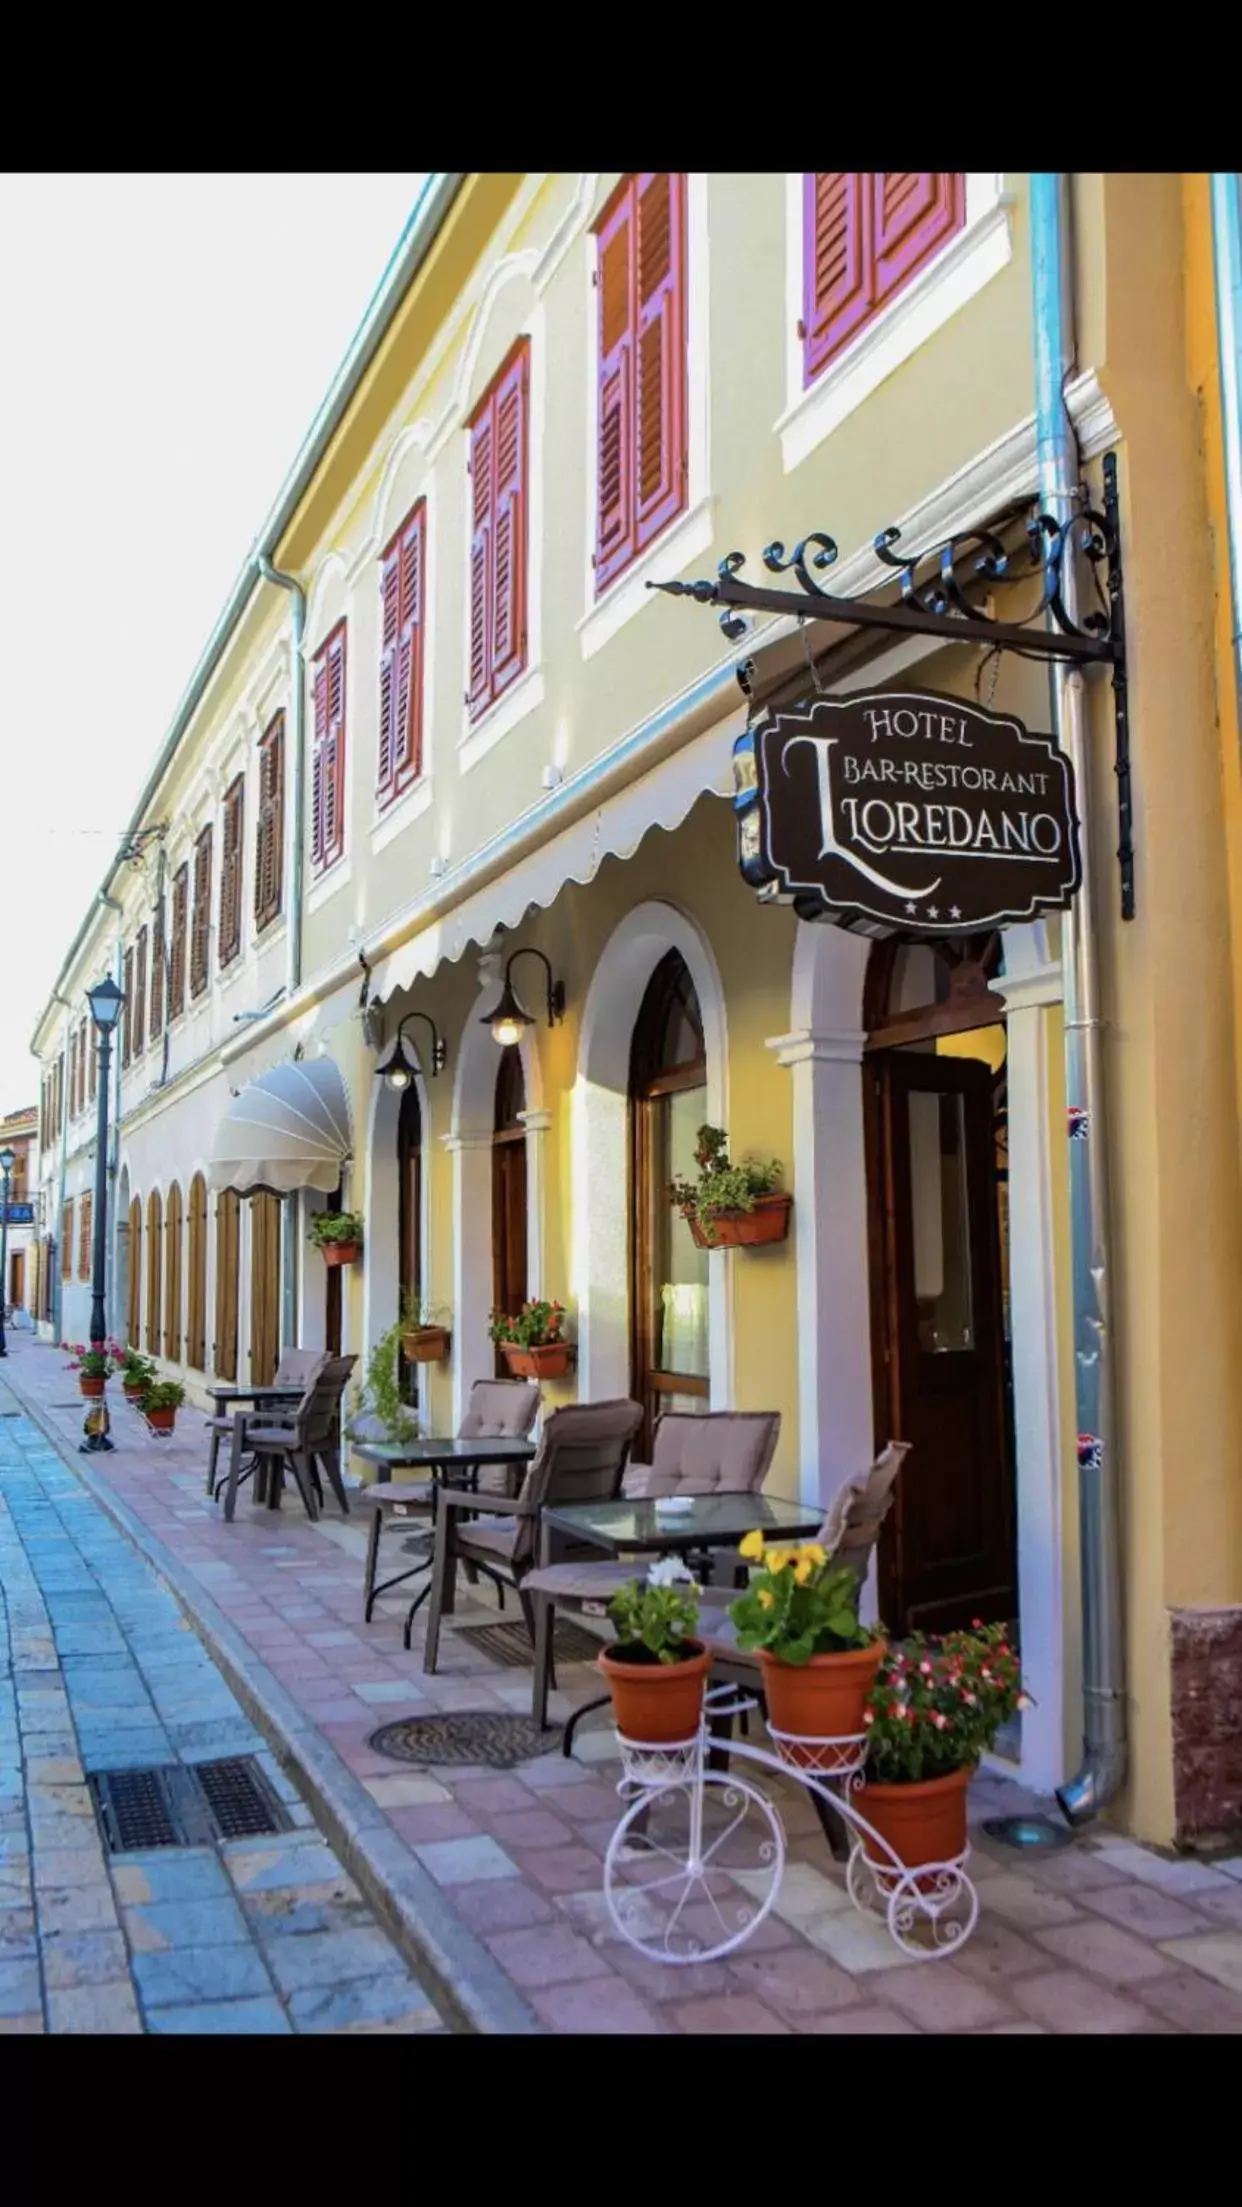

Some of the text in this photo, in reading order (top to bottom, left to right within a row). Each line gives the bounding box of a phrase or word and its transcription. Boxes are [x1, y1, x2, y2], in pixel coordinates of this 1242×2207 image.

[863, 708, 974, 747] HOTEL
[843, 755, 1050, 796] BAR-RESTORANT
[841, 798, 1061, 854] LOREDANO
